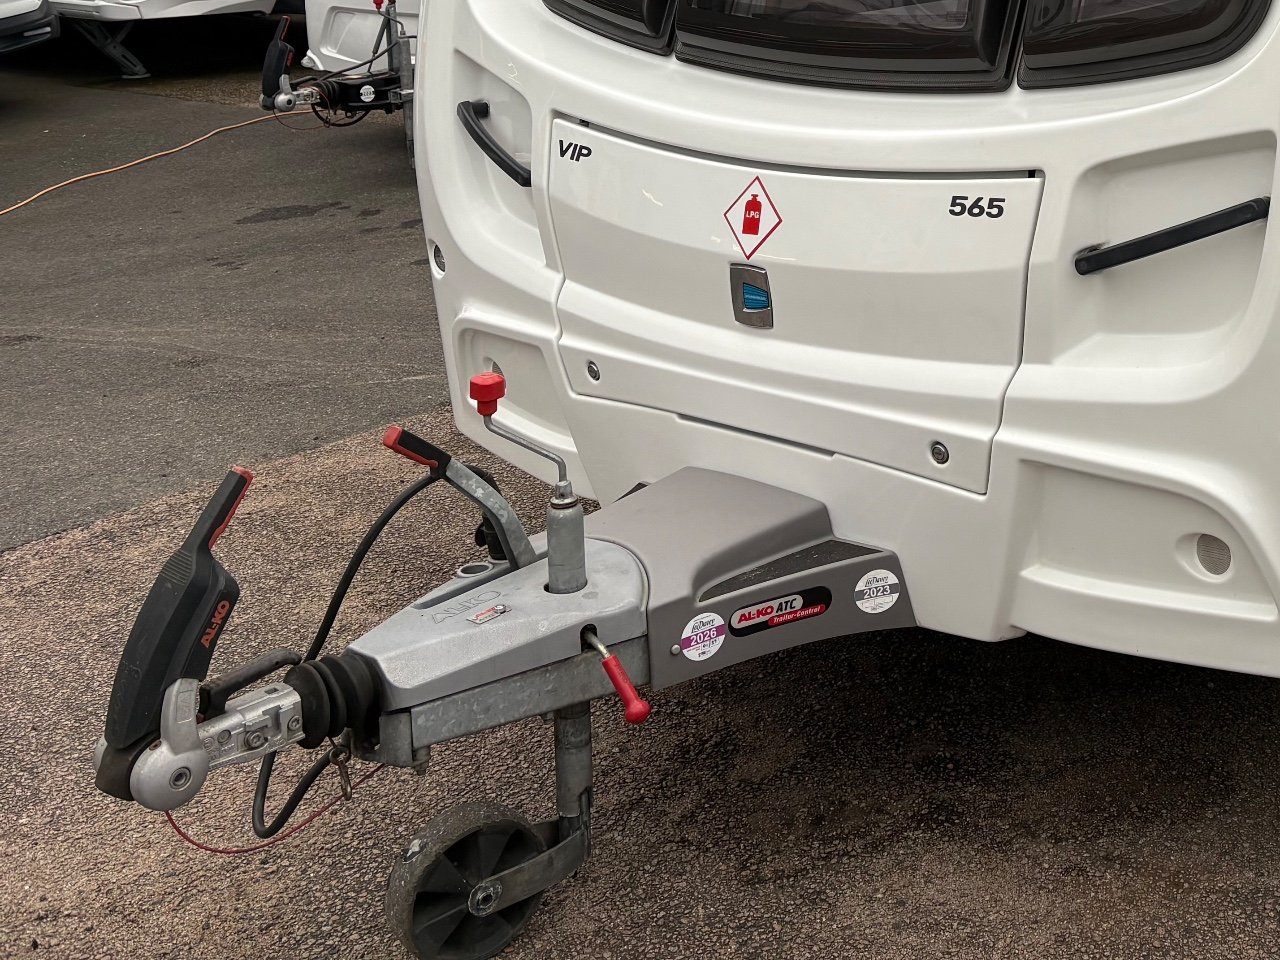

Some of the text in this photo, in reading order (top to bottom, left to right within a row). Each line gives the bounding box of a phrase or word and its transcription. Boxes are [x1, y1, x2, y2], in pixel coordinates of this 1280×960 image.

[558, 139, 593, 162] VIP
[745, 210, 760, 219] LPG
[948, 195, 1006, 219] 565
[863, 585, 891, 600] 2023
[737, 597, 797, 625] AL-KO ATC
[200, 600, 230, 649] AL-KO
[690, 627, 717, 646] 2026
